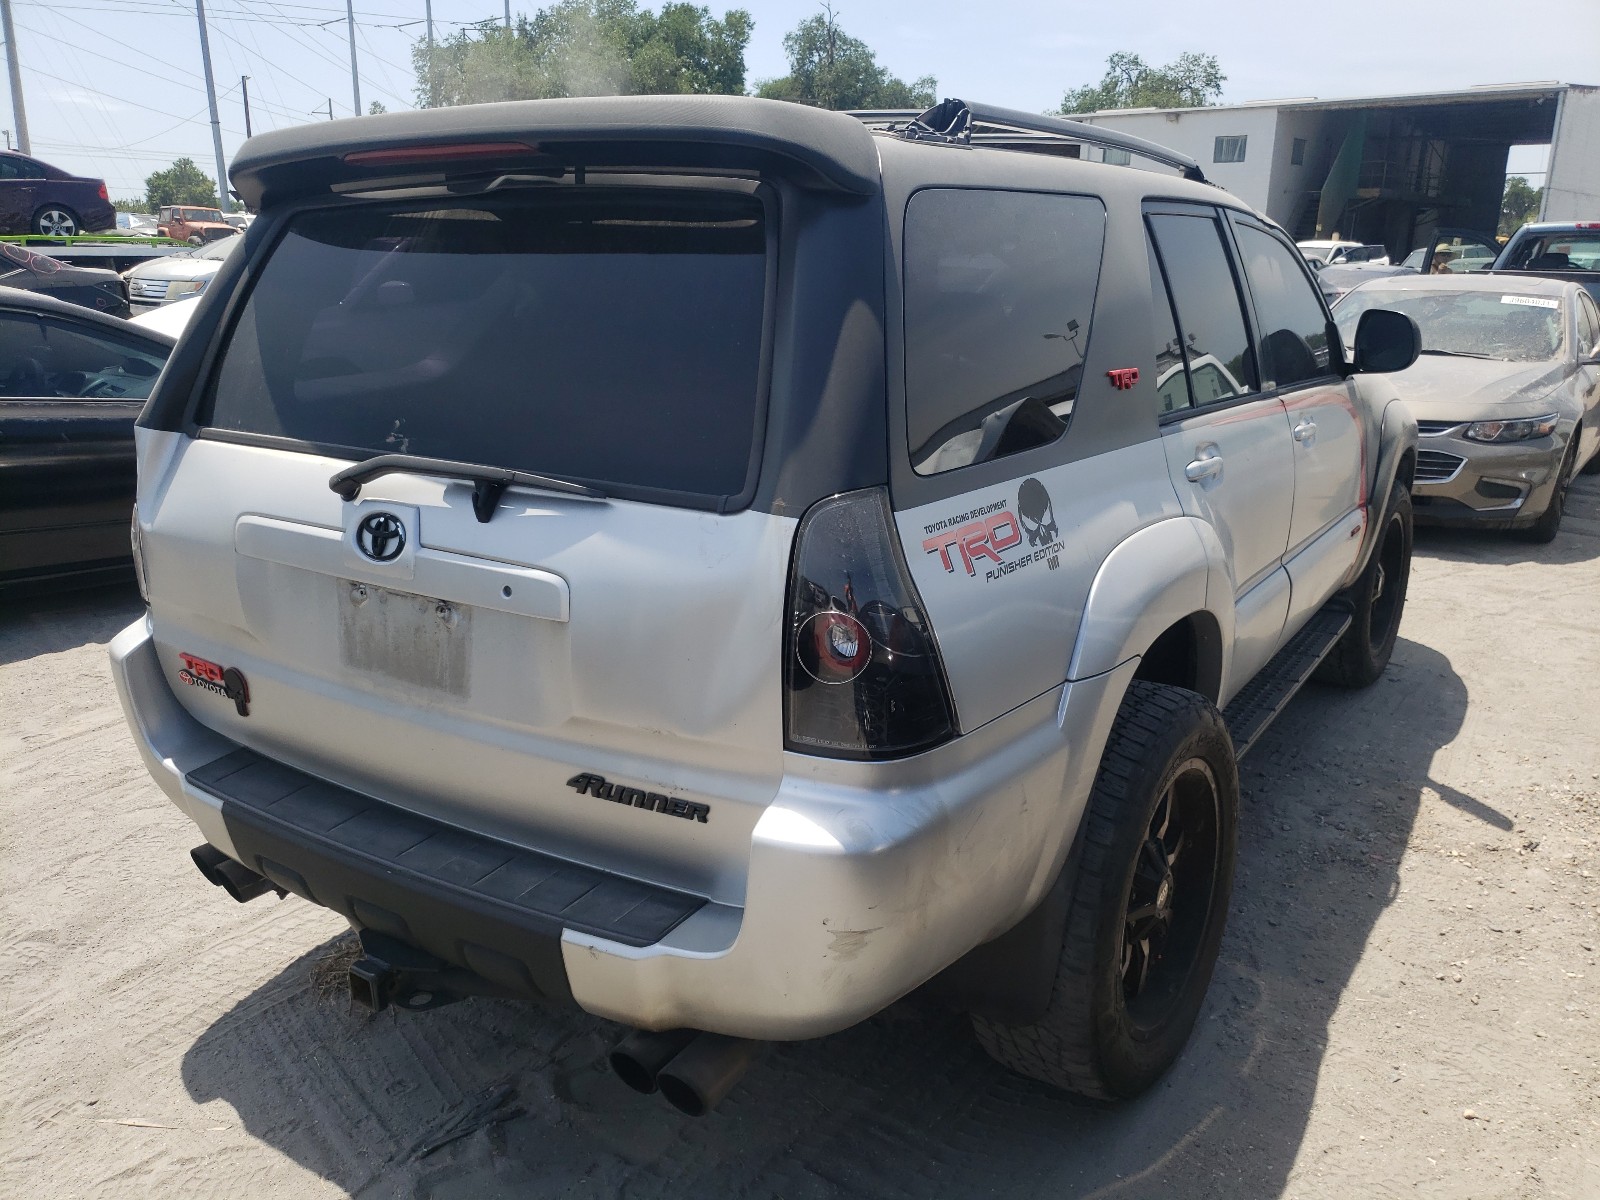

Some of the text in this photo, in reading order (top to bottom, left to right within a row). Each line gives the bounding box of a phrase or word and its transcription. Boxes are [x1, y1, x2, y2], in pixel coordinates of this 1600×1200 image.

[1105, 367, 1139, 390] TRD
[924, 499, 1007, 534] TOYOTA RACING DEVELOPMENT
[922, 511, 1022, 577] TRD
[985, 540, 1066, 583] PUNISHER EDITION
[179, 652, 225, 682] TRD
[192, 677, 228, 698] TOYOTA
